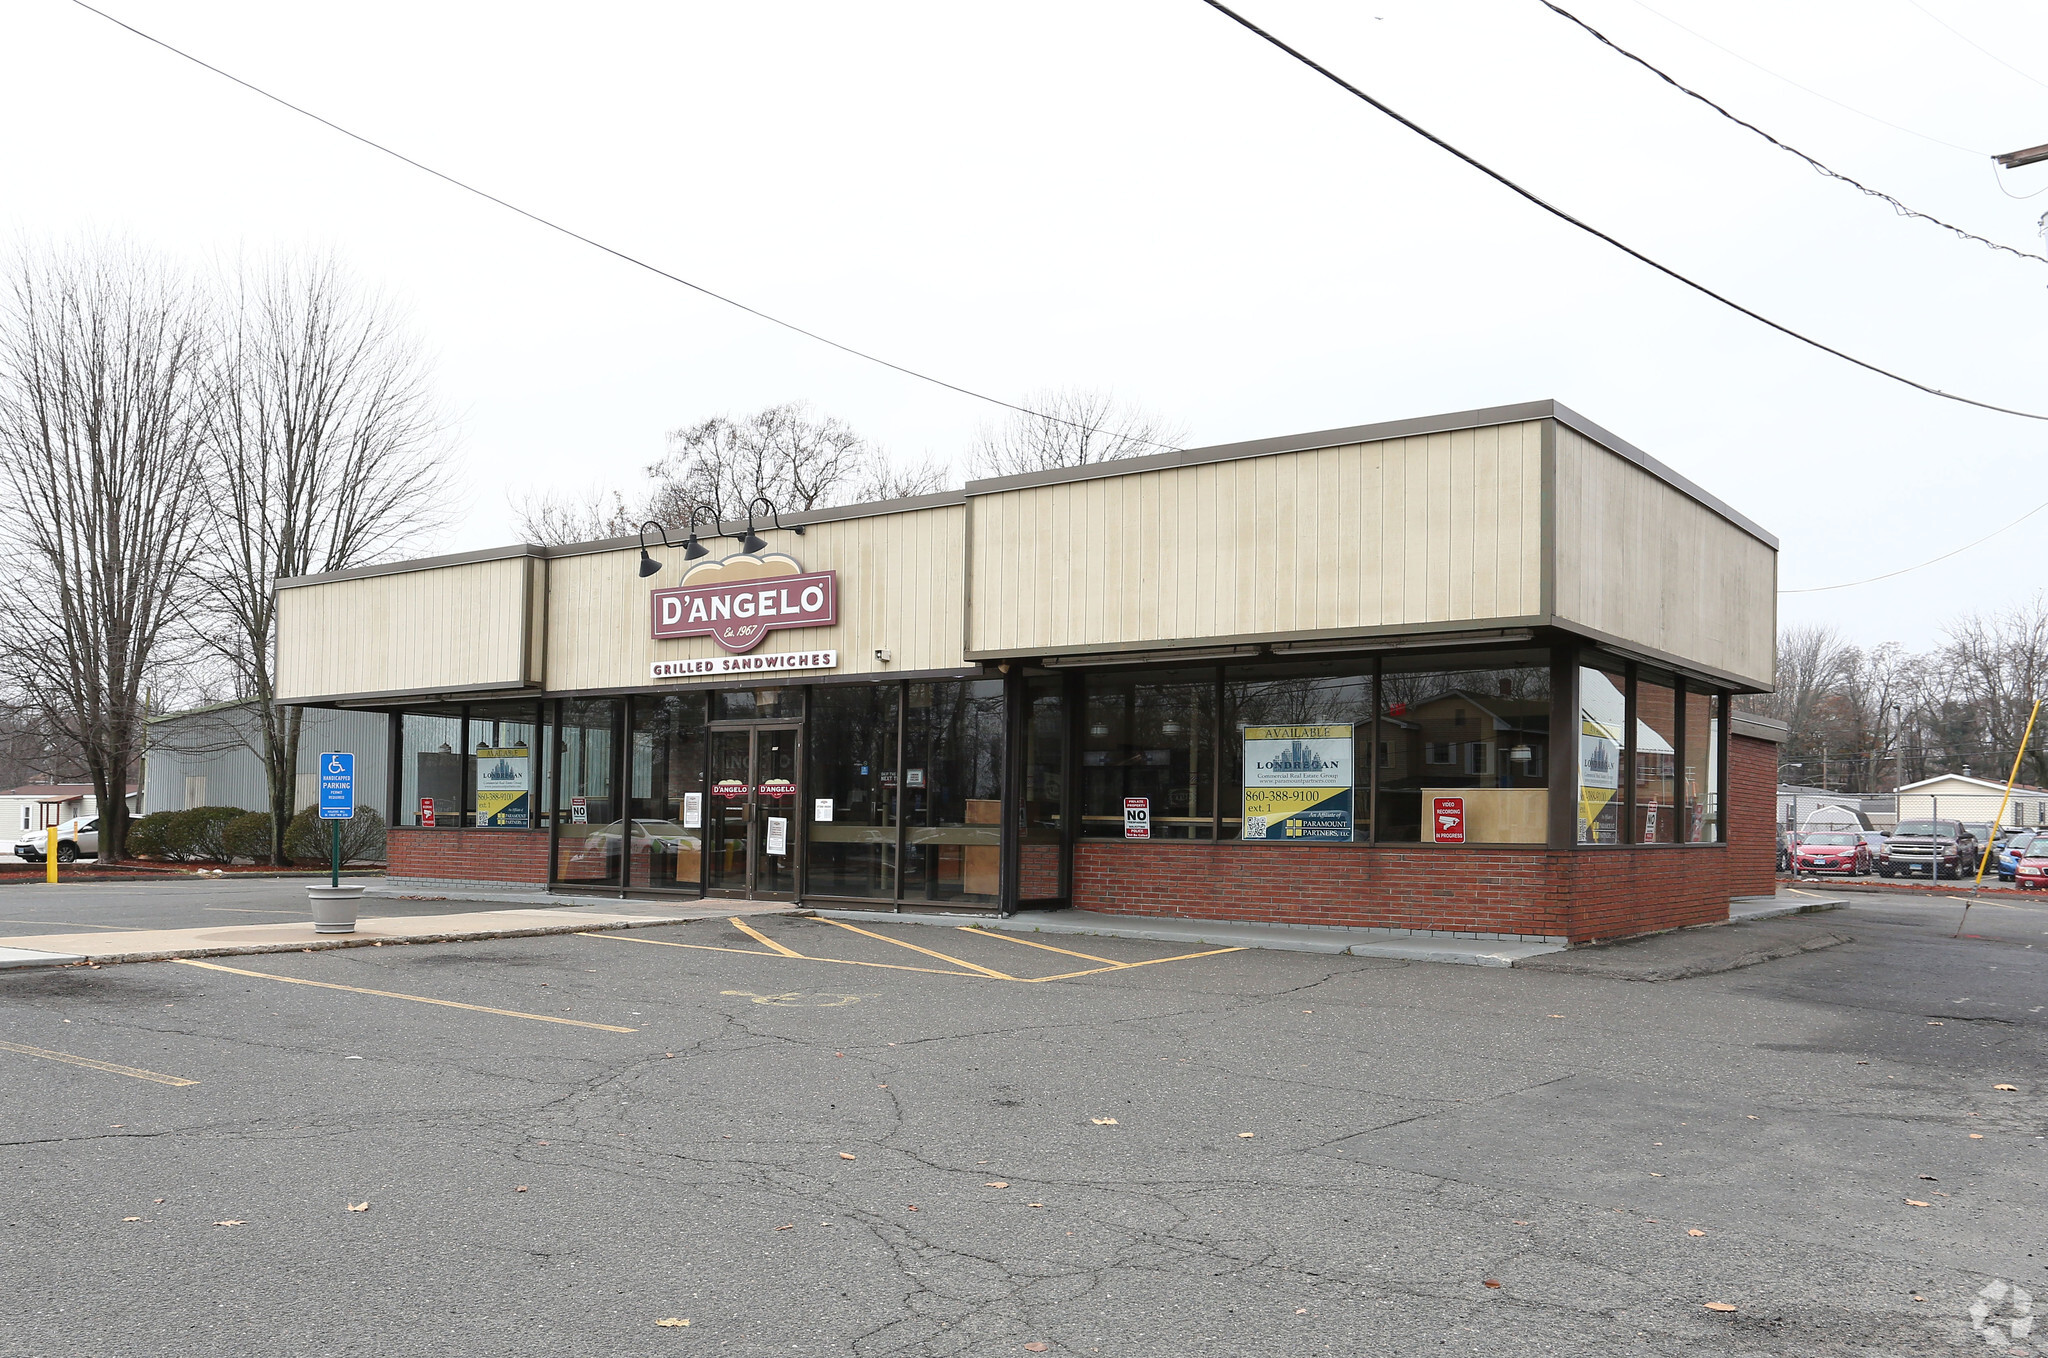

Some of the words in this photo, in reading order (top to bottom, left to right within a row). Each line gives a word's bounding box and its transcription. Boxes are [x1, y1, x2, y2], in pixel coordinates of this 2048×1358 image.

[662, 585, 824, 625] D'ANGELO
[724, 627, 735, 638] Est.
[736, 625, 758, 637] 1967
[653, 660, 714, 676] GRILLED
[722, 653, 831, 671] SANDWICHES
[1265, 727, 1331, 739] AVAILABLE
[1257, 760, 1339, 770] LONDREGAN
[1245, 790, 1320, 802] 860-388-9100
[573, 807, 585, 815] NO
[1248, 804, 1265, 812] ext.
[1267, 803, 1271, 812] 1
[1127, 810, 1146, 820] NO
